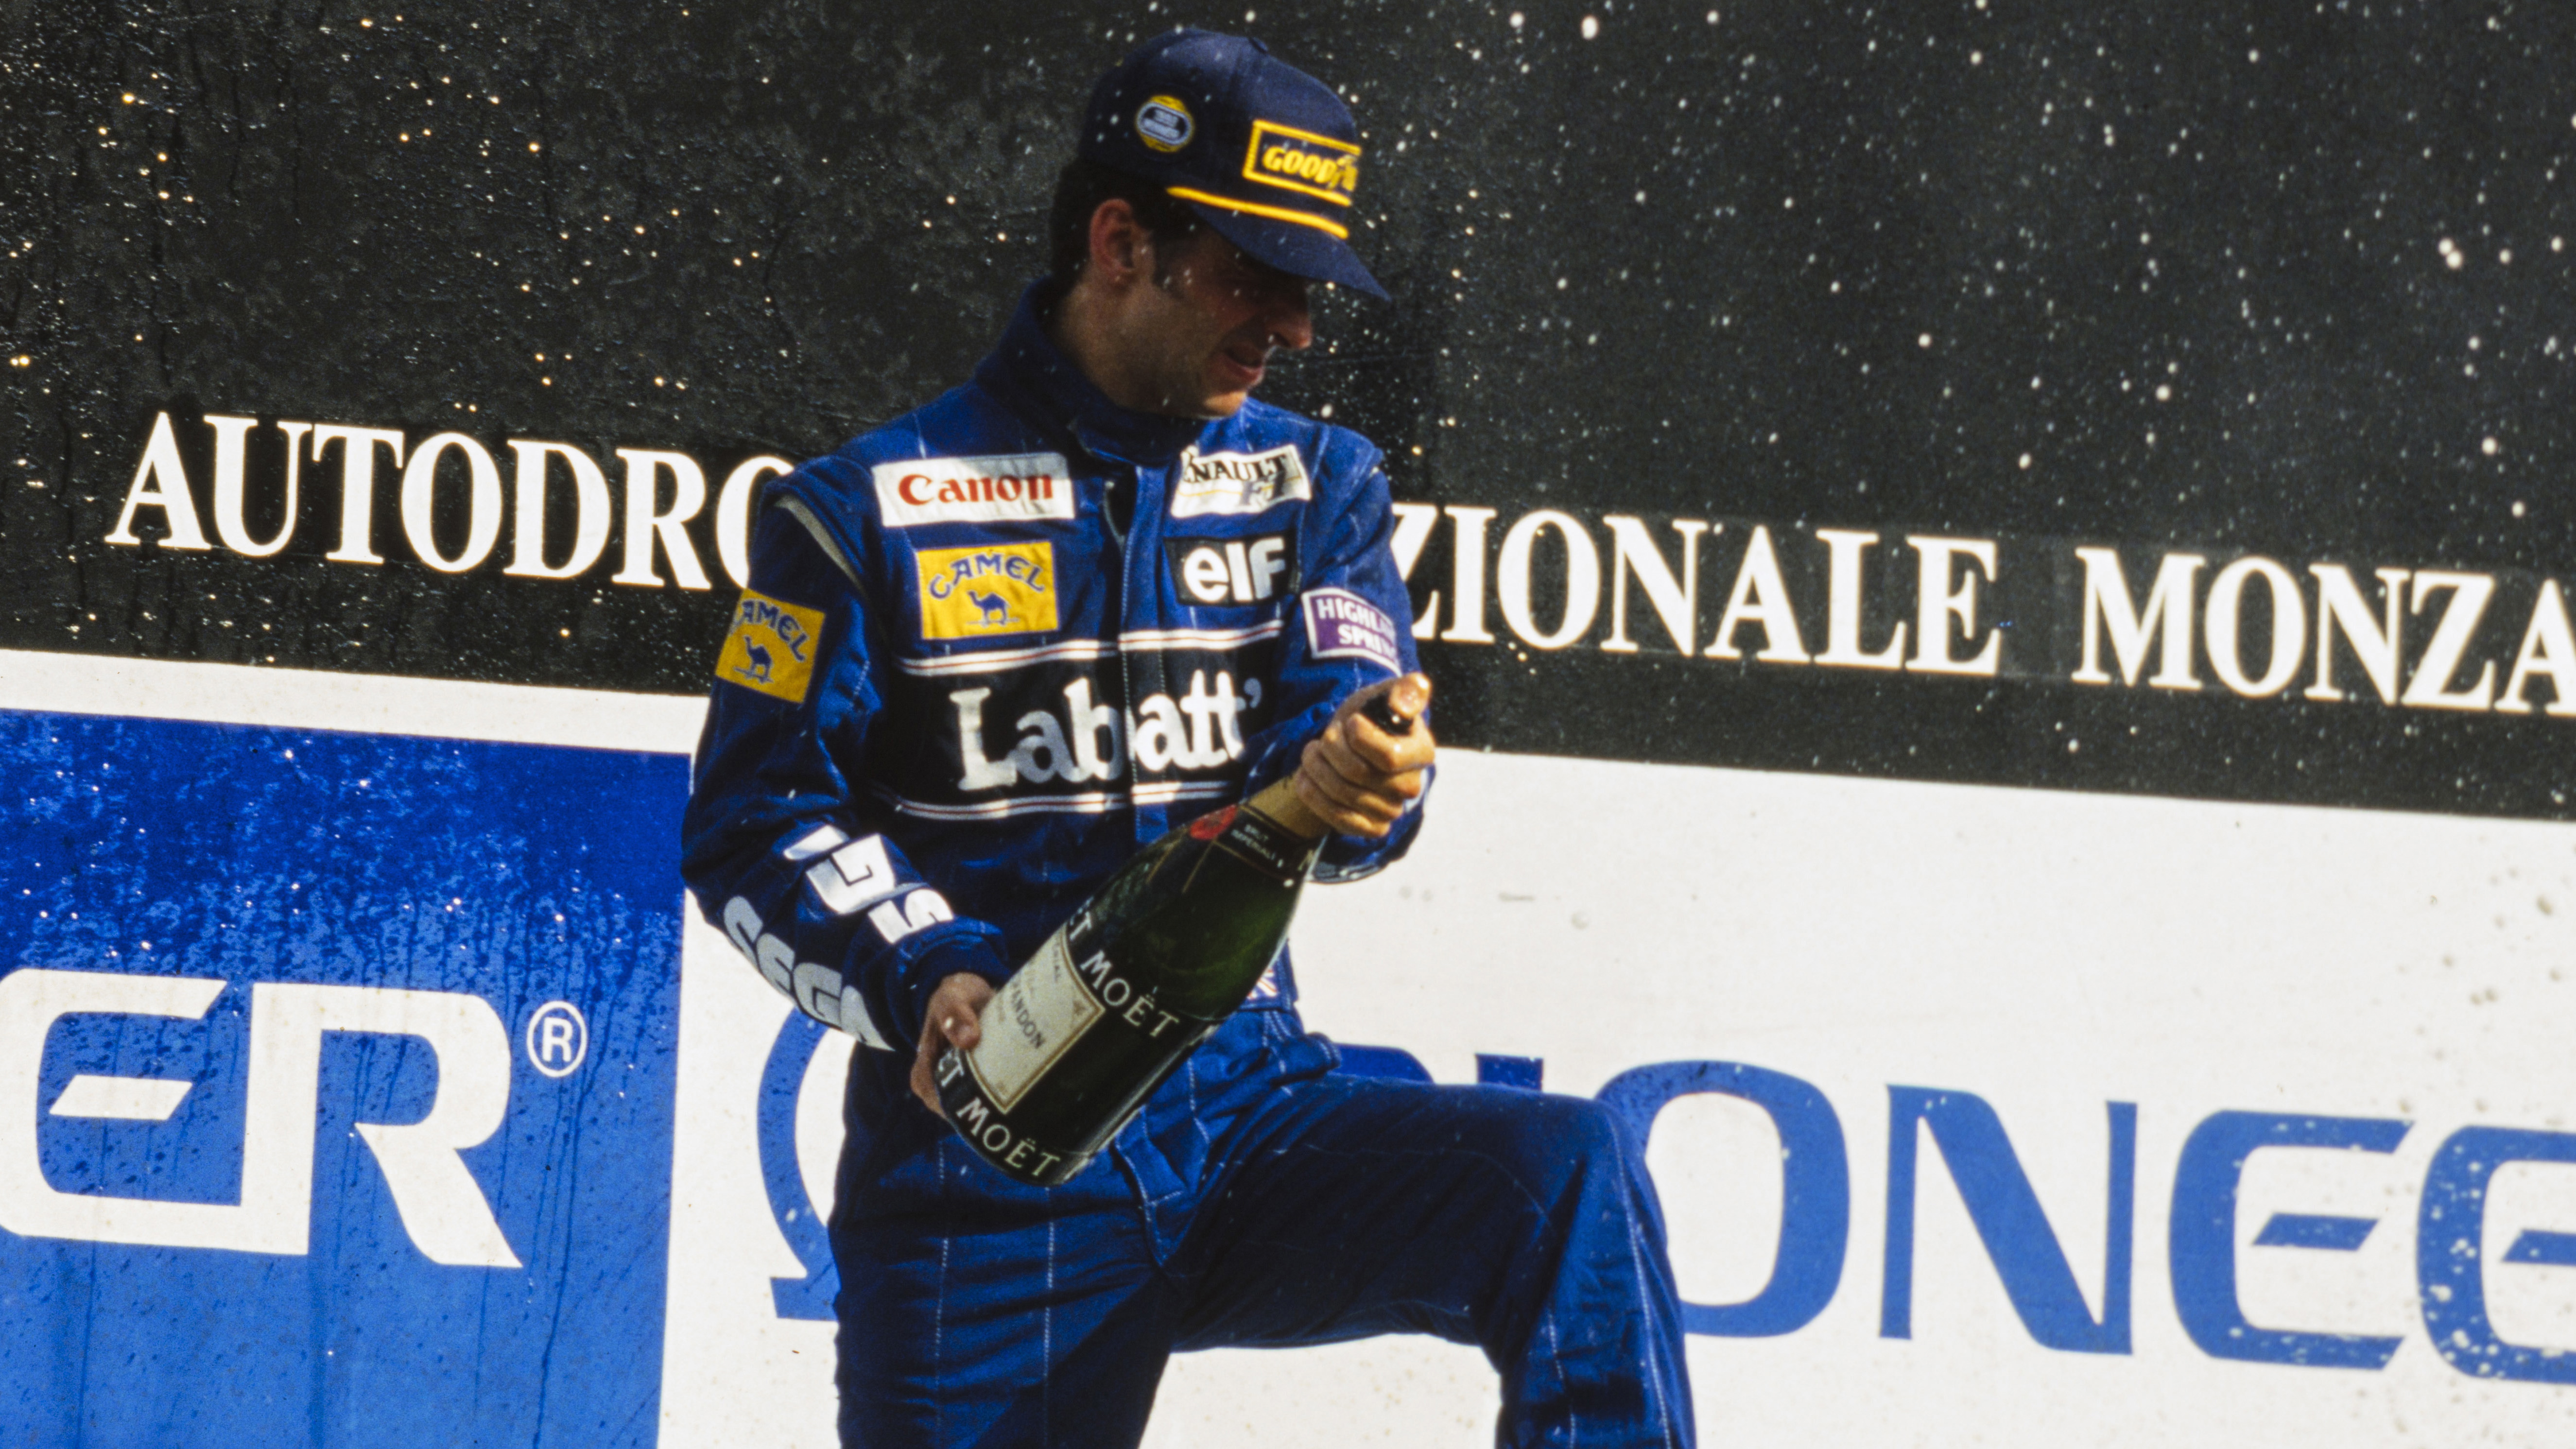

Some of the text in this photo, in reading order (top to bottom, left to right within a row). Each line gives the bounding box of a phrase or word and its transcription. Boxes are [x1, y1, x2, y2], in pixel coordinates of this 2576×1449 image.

[1262, 145, 1359, 191] GOOD
[898, 473, 1054, 506] Canon
[1184, 454, 1286, 483] NAULT
[929, 552, 1045, 600] CAMEL
[1183, 536, 1286, 603] elf
[732, 599, 808, 661] AMEL
[2071, 546, 2576, 716] MONZA
[1079, 949, 1180, 1037] MOËT
[0, 968, 523, 1268] ER
[956, 1096, 1060, 1177] MOËT
[1332, 1043, 2576, 1386] ONEE
